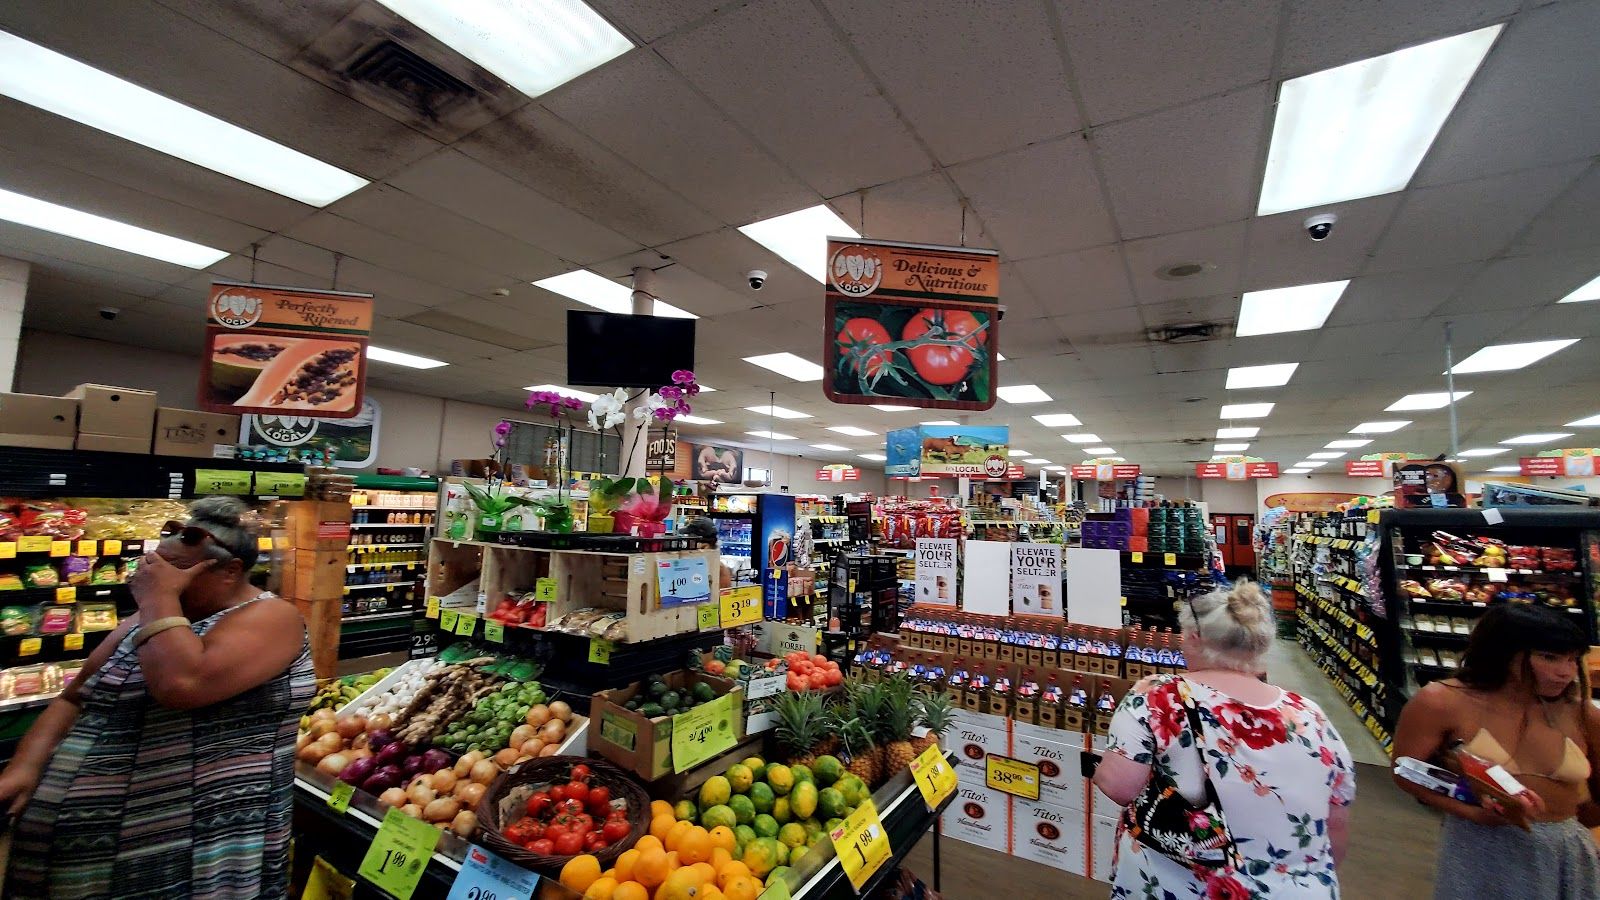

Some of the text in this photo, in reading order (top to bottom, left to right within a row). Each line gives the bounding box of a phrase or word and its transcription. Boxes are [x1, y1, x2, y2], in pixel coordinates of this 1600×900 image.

[893, 258, 982, 277] Delicious &
[839, 280, 871, 293] LOCAL
[905, 274, 988, 292] Nutritious
[275, 299, 338, 315] Perfectly
[221, 316, 251, 326] LOCAL
[301, 313, 359, 327] Ripened
[265, 427, 306, 442] LOCAL
[649, 439, 675, 458] FOODS
[920, 542, 952, 551] ELEVATE
[1016, 548, 1055, 557] ELEVATE
[920, 550, 952, 561] YOUR
[1017, 555, 1056, 569] YOUR
[961, 730, 989, 744] Tito's
[1033, 746, 1065, 761] Tito's
[960, 788, 989, 803] Tito's
[1033, 807, 1065, 824] Tito's
[957, 817, 992, 832] Handmade
[1030, 838, 1068, 854] Handmade
